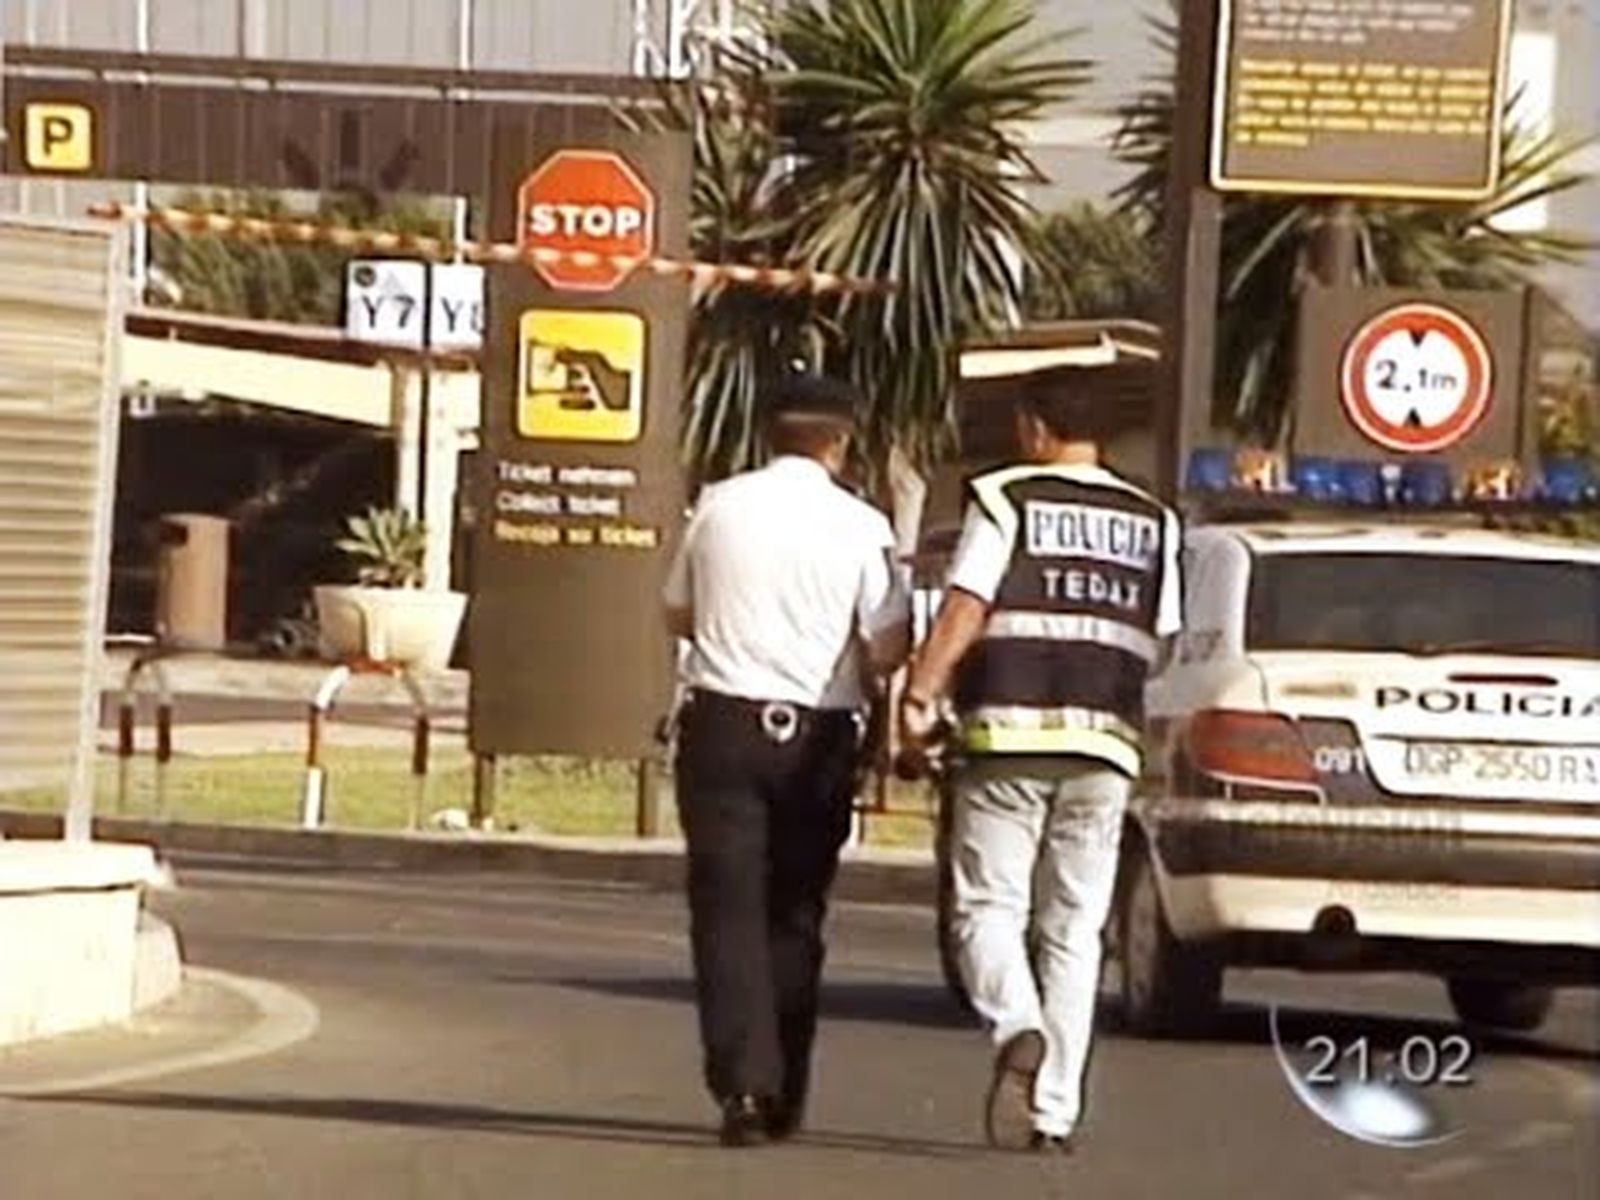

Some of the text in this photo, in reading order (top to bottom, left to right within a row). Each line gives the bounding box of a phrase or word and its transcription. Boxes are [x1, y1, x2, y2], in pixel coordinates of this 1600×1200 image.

[43, 115, 74, 156] P
[530, 203, 642, 238] STOP
[361, 295, 416, 328] Y7
[1031, 507, 1152, 560] POLICIA
[1314, 745, 1367, 775] 091
